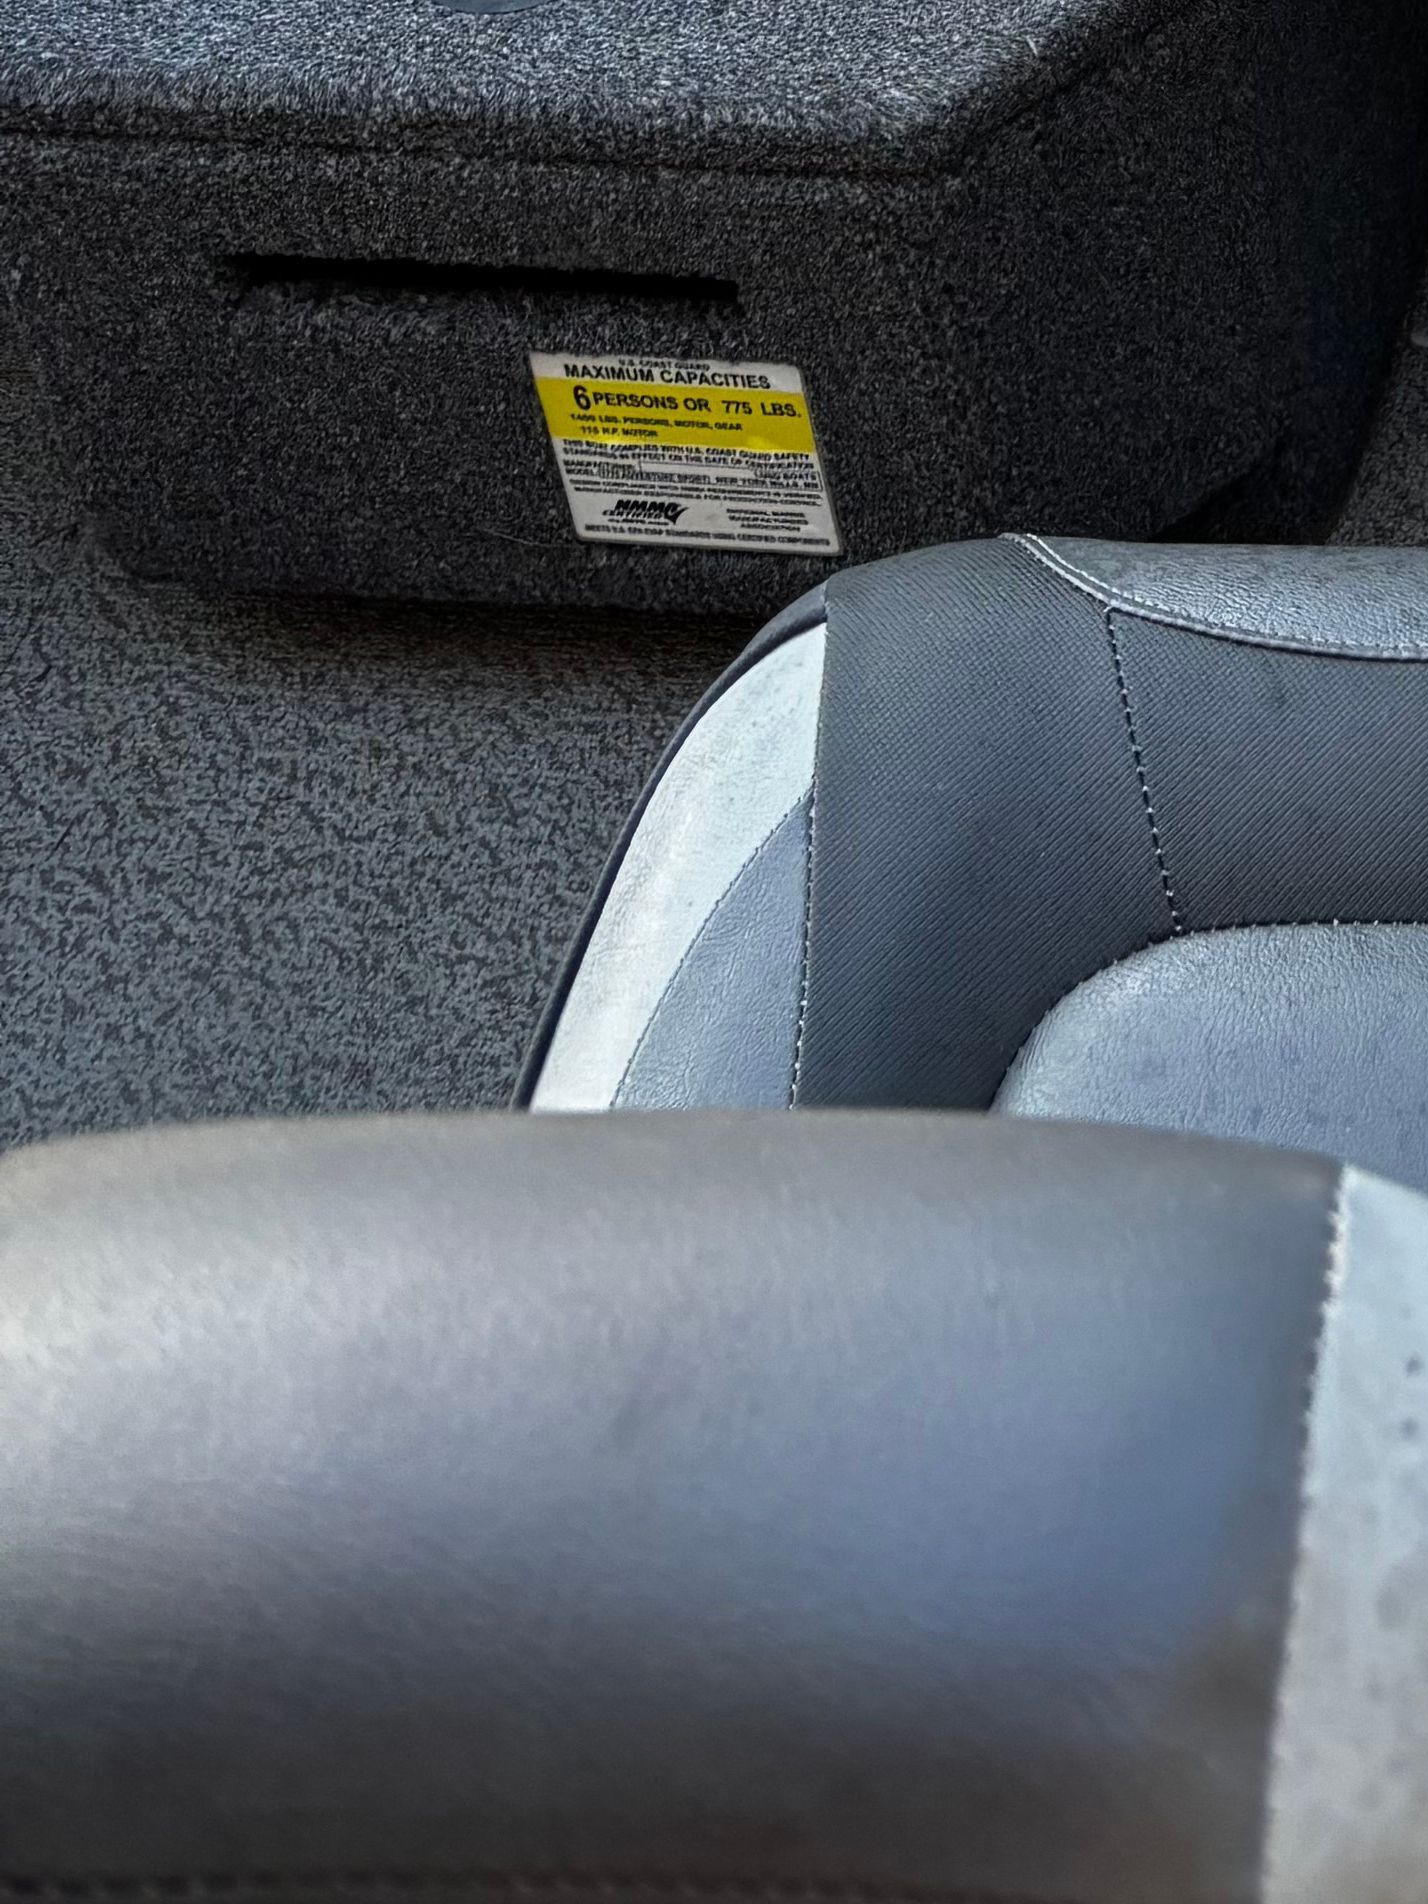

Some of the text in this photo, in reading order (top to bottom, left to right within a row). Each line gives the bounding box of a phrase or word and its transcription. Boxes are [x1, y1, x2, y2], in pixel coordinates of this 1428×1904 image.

[563, 364, 771, 389] MAXIMUM CAPACITIES
[573, 385, 802, 418] 6 PERSONS OR 775 LBS.
